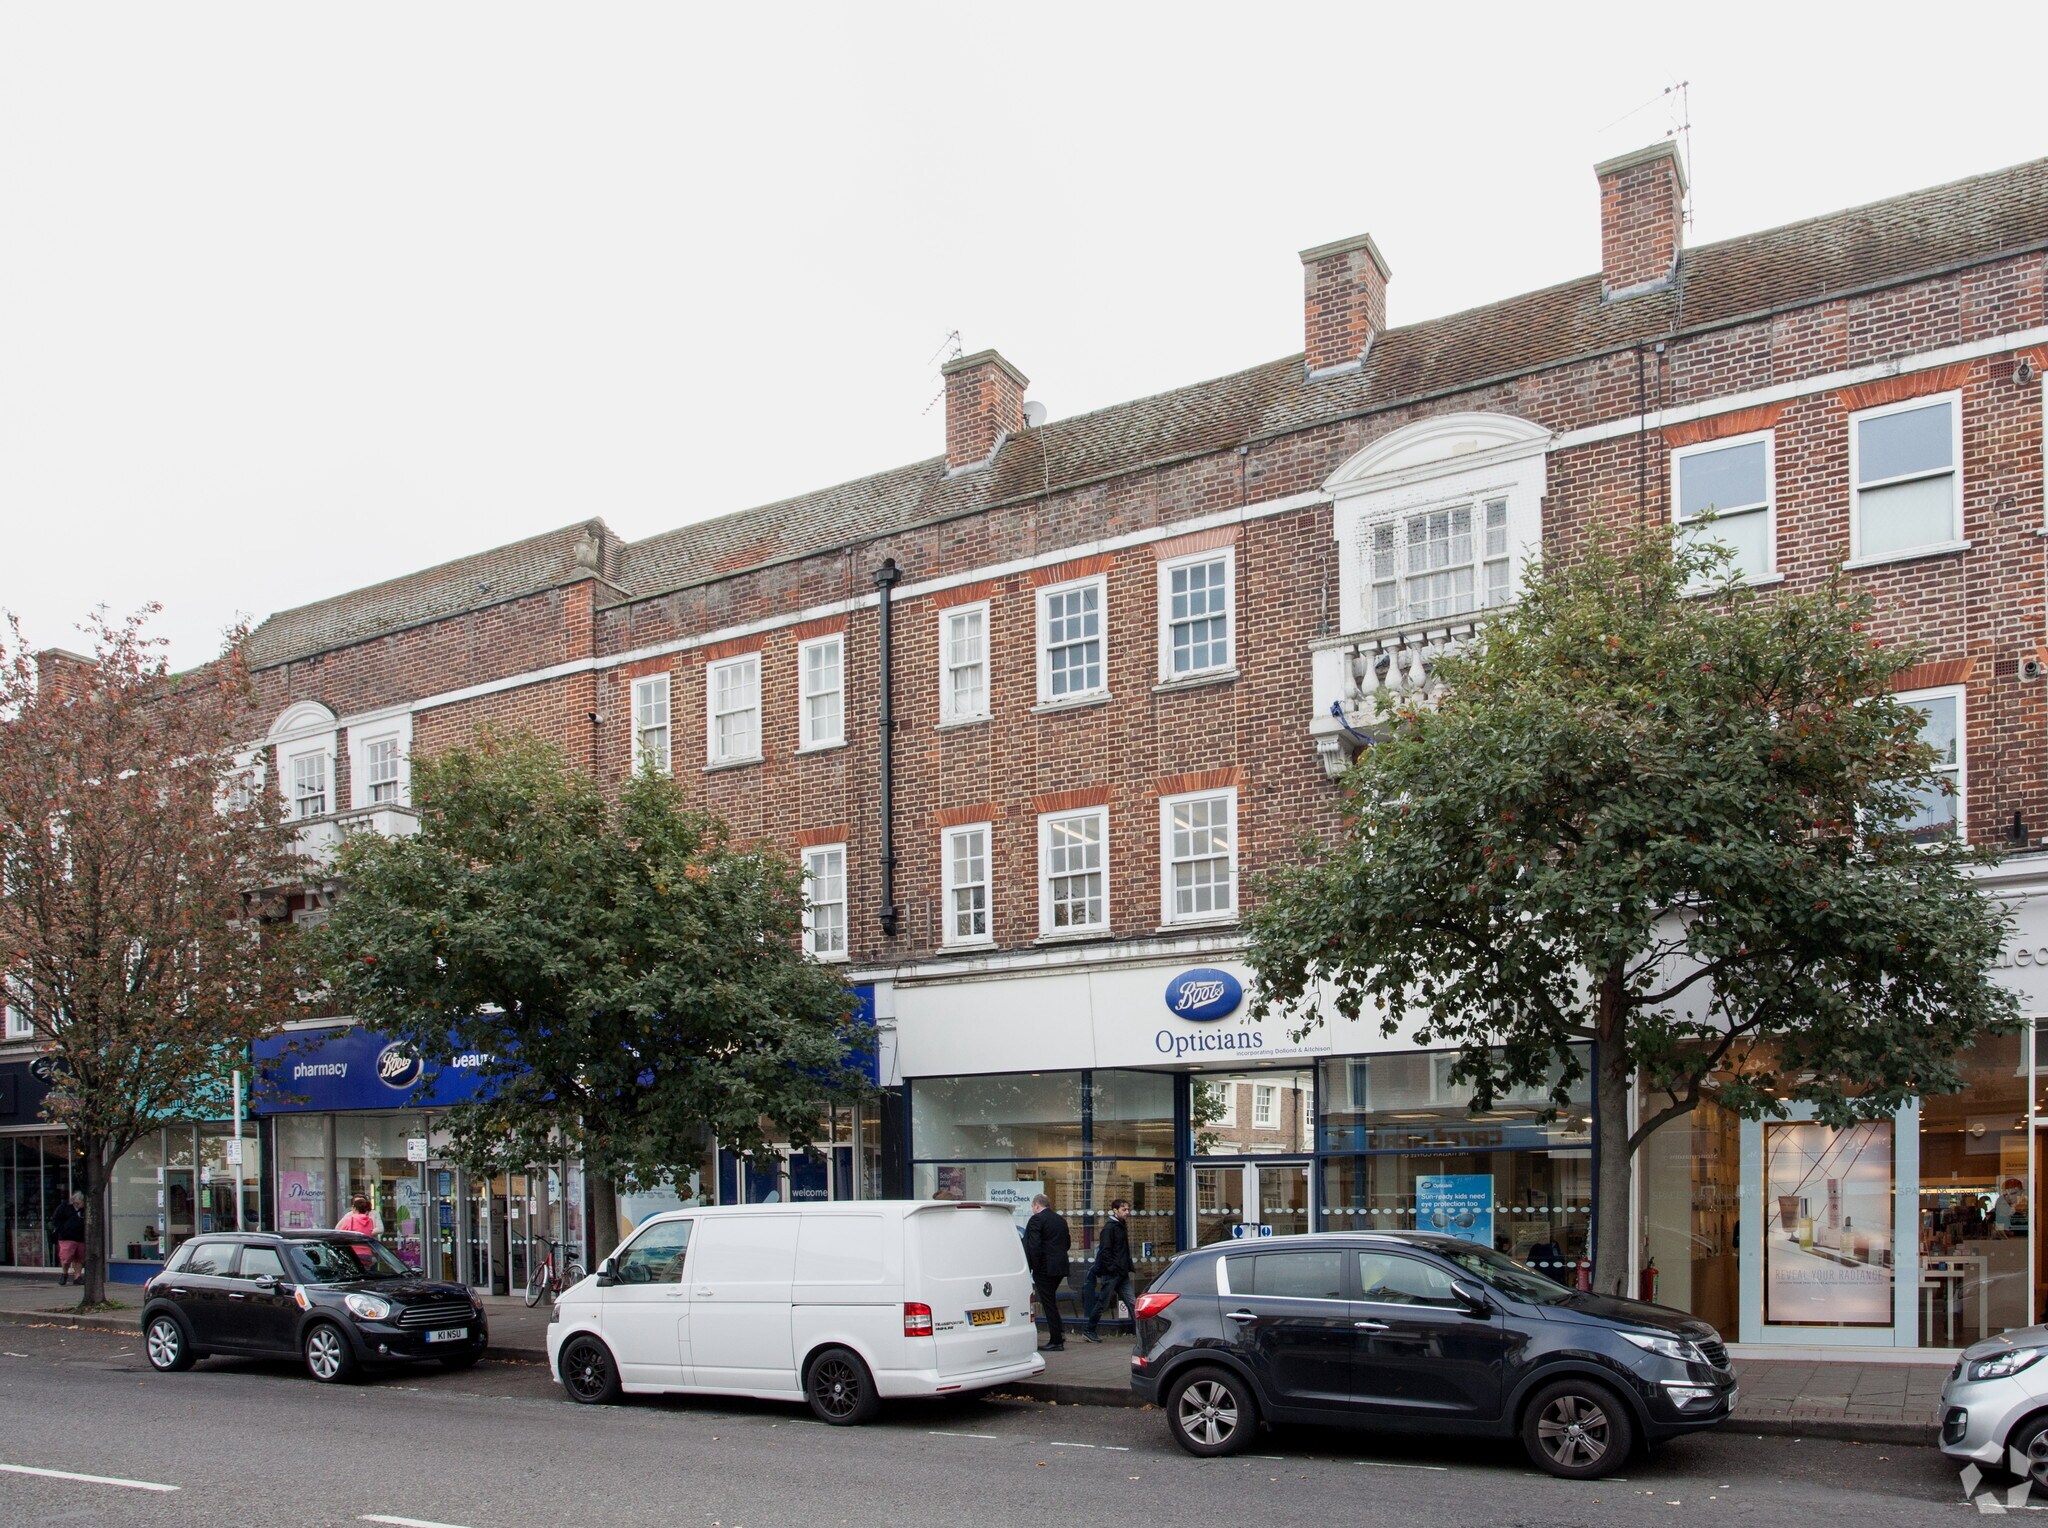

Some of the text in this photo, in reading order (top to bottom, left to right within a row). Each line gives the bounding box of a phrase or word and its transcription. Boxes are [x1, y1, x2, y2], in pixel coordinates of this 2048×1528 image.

[1175, 980, 1225, 1011] Boots
[1155, 1029, 1263, 1057] Opticians
[1236, 1049, 1273, 1057] incorporating
[294, 1062, 348, 1080] pharmacy
[792, 1186, 828, 1197] welcome
[1775, 1269, 1882, 1280] REVEAL YOUR RADIANCE
[972, 1311, 991, 1322] EX63
[447, 1330, 461, 1339] NSU
